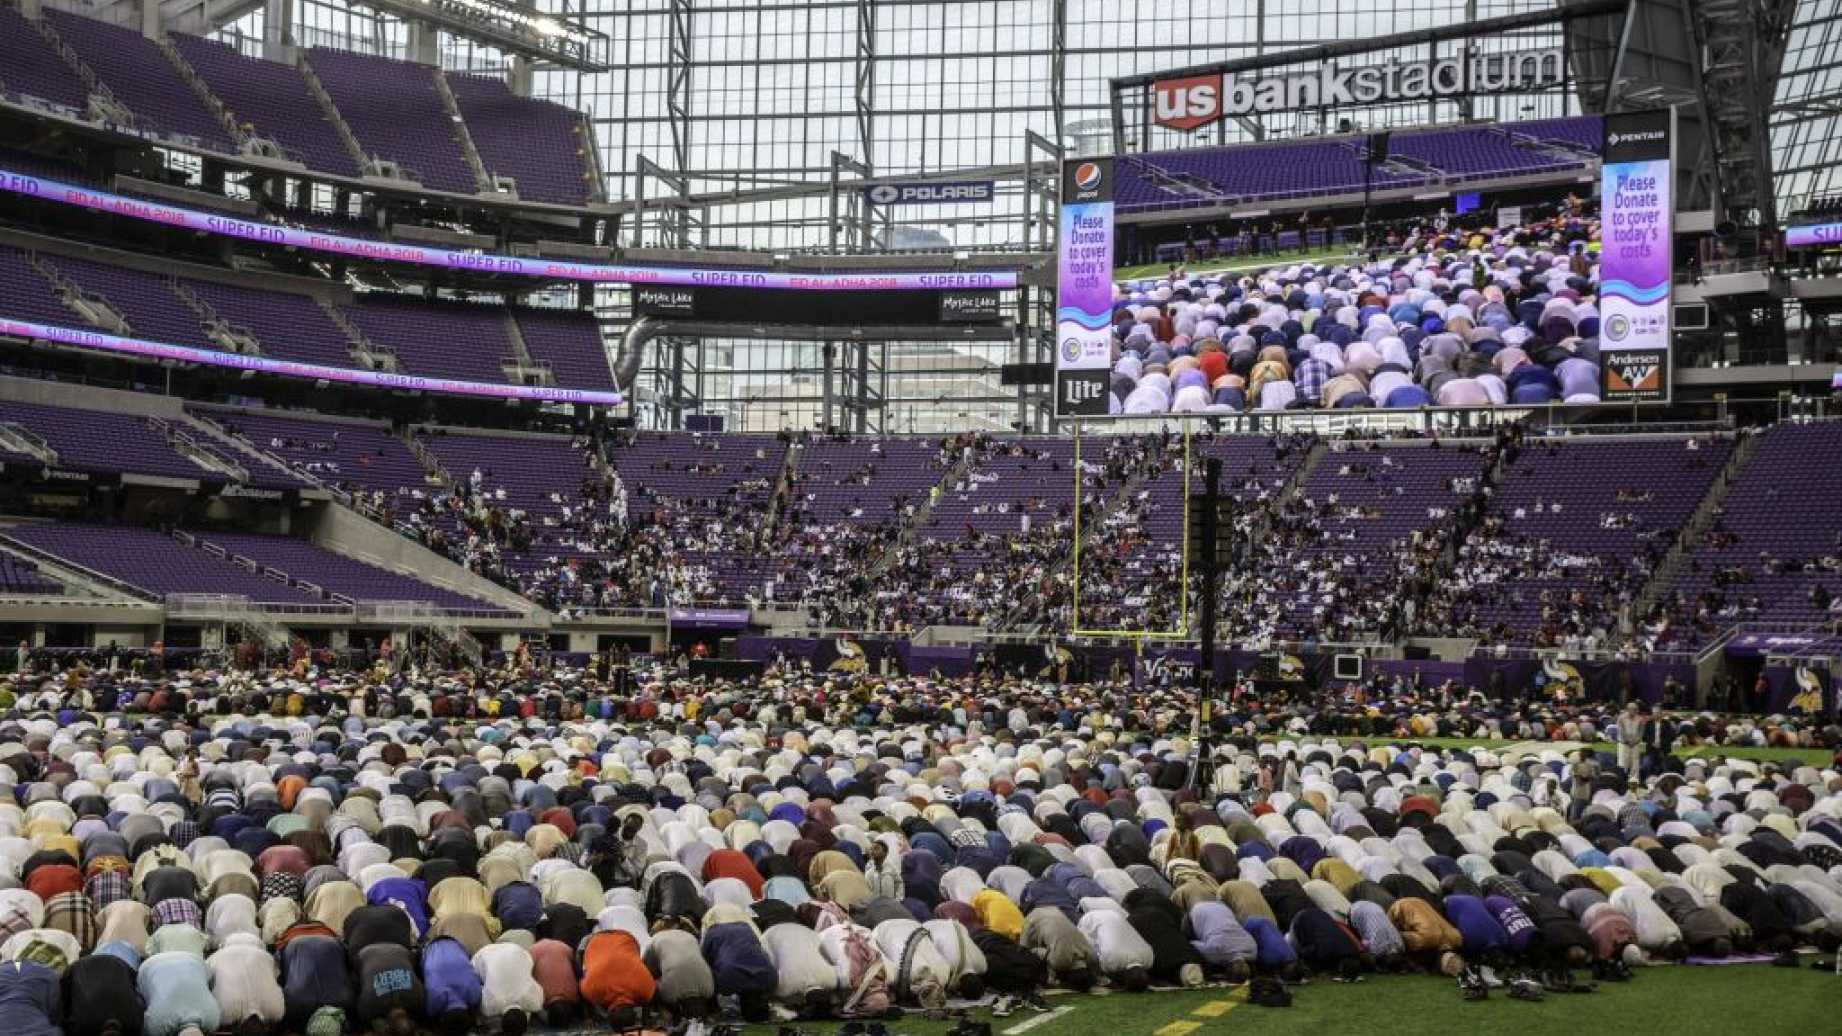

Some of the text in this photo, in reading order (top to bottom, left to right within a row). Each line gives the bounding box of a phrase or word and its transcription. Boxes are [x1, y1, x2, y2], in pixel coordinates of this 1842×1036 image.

[11, 175, 39, 194] EID
[1616, 175, 1656, 192] Please
[902, 185, 988, 200] POLARIS
[1614, 192, 1658, 209] Donate
[1073, 213, 1104, 228] Please
[1612, 210, 1661, 226] to cover
[207, 216, 286, 242] SUPER EID
[1614, 226, 1659, 246] today's
[1071, 231, 1105, 245] Donate
[1069, 248, 1107, 261] to cover
[1620, 243, 1651, 259] costs
[447, 252, 523, 273] SUPER EID
[1070, 261, 1105, 276] today's
[691, 271, 766, 287] SUPER EID
[918, 274, 993, 289] SUPER EID
[1075, 275, 1099, 288] costs
[1607, 353, 1660, 366] Anderson
[1064, 380, 1104, 404] Lite
